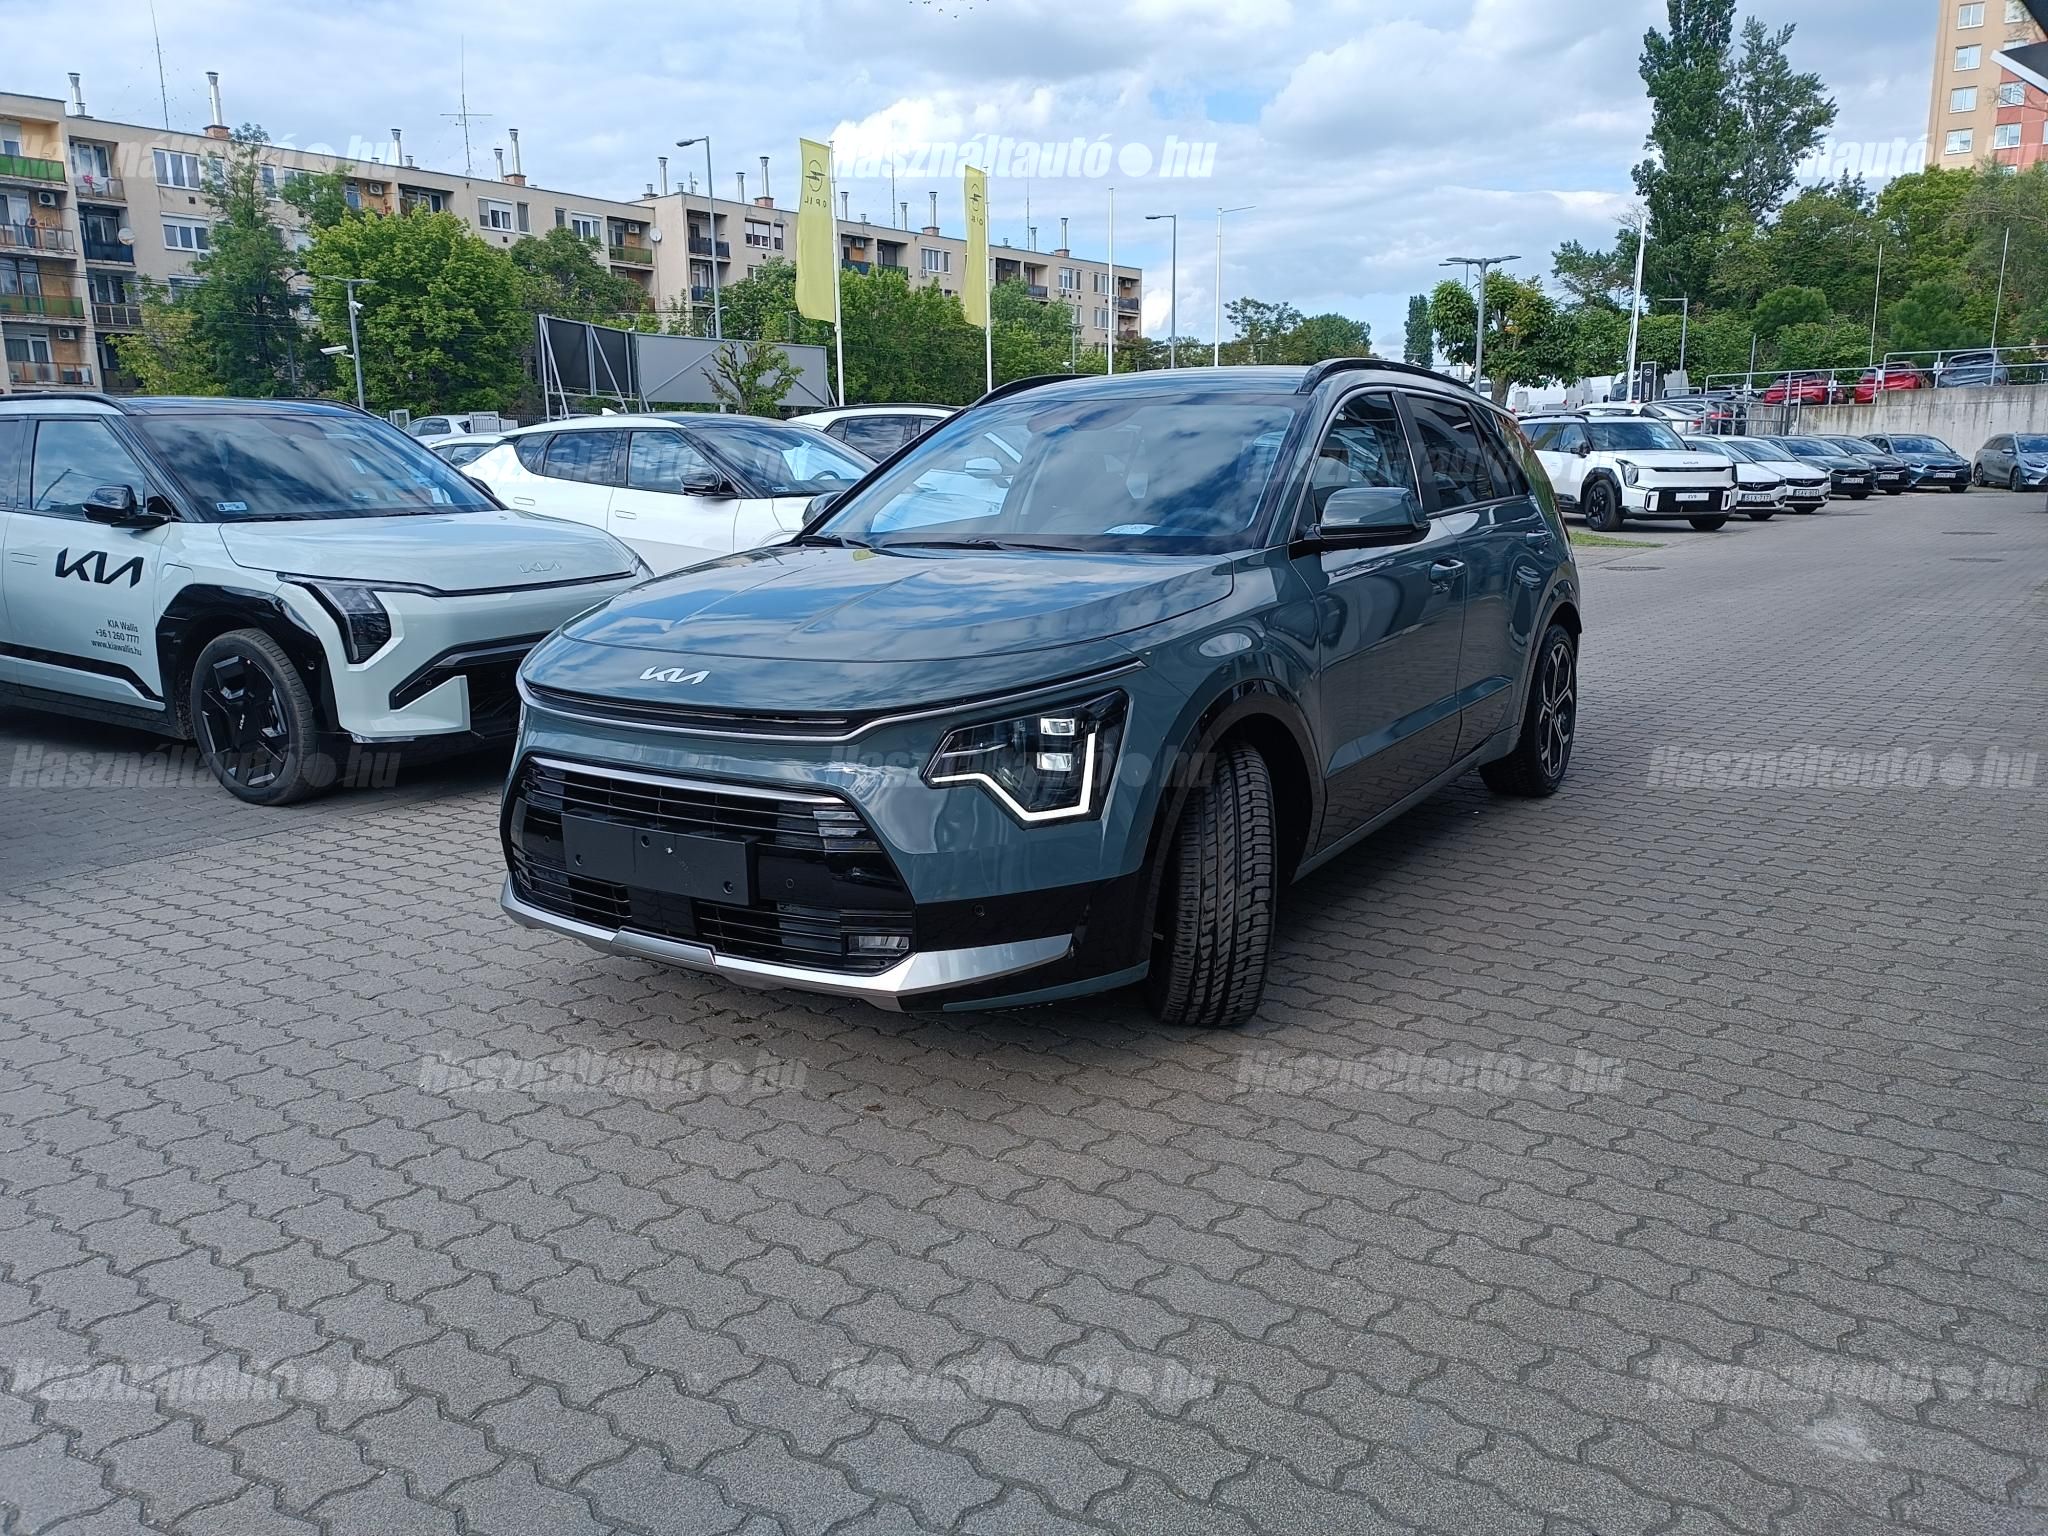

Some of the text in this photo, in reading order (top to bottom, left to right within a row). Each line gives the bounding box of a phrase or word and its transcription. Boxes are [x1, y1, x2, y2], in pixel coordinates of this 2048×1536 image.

[55, 547, 144, 588] KIA
[107, 619, 119, 629] KIA
[96, 629, 107, 637] +36
[640, 666, 710, 684] KIA
